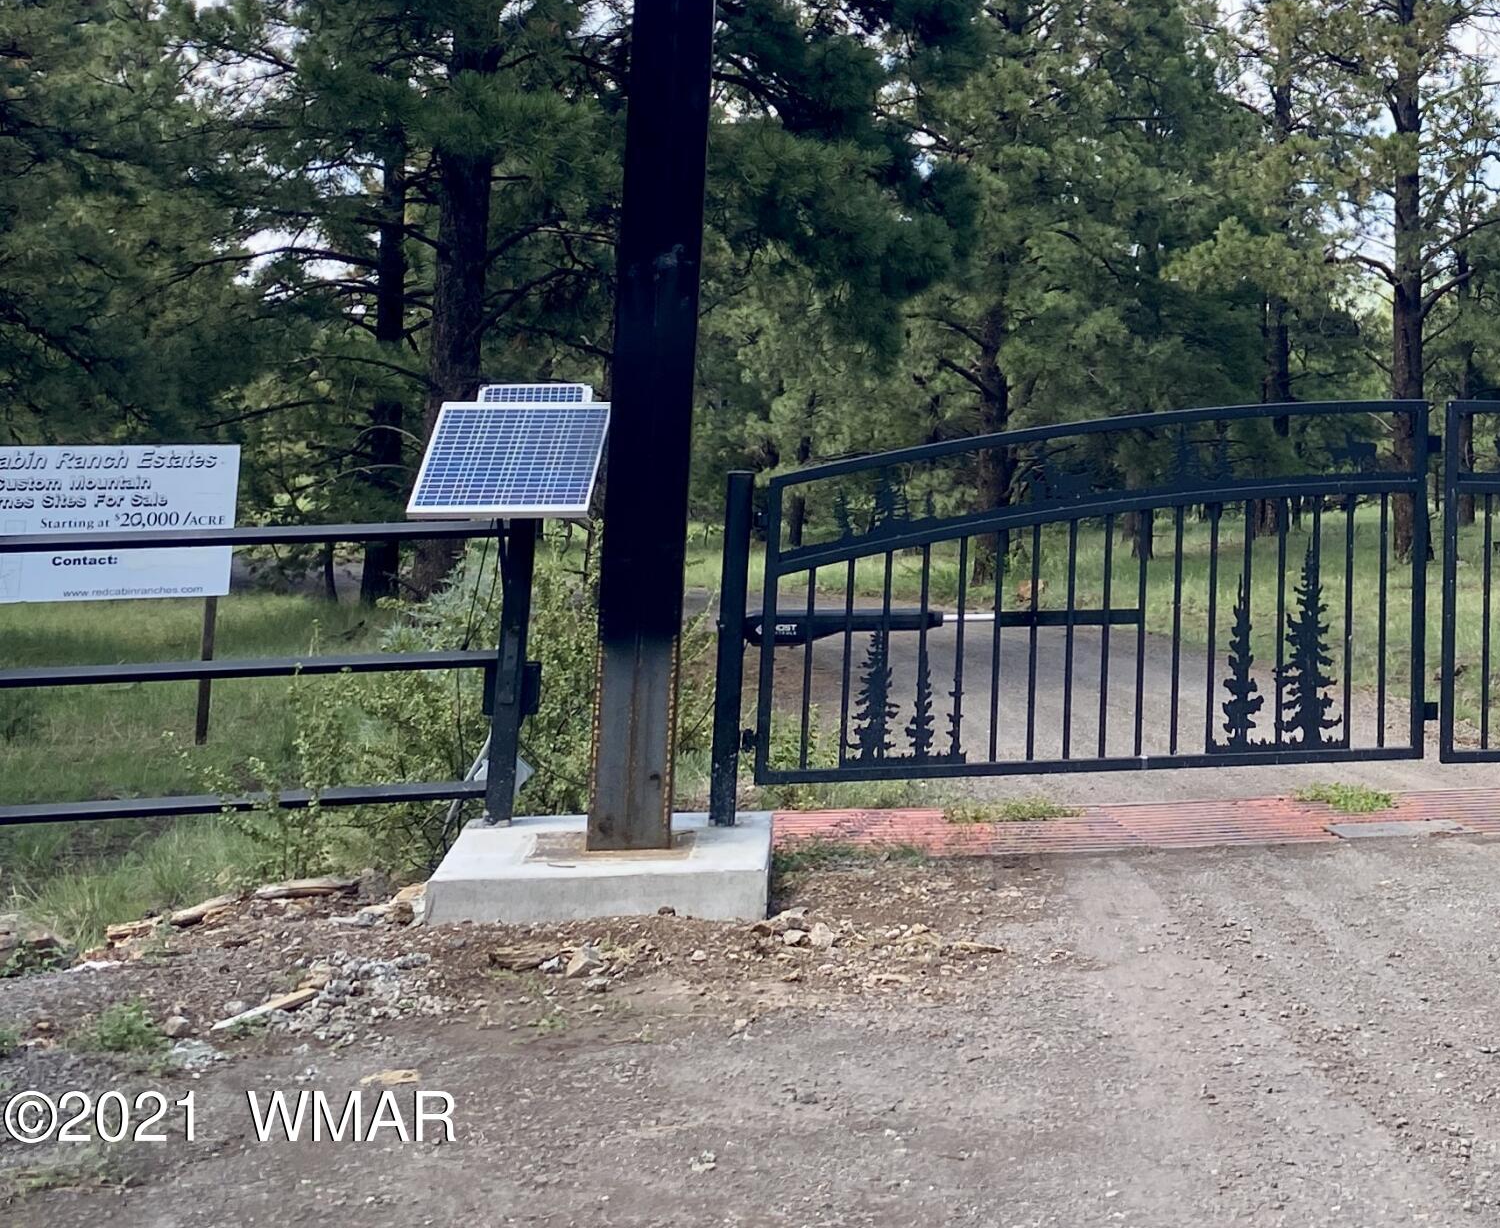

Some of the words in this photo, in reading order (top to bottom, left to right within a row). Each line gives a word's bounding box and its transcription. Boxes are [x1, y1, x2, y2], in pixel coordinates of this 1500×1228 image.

[0, 451, 48, 470] abin
[56, 450, 129, 469] Ranch
[137, 449, 218, 469] Estates
[69, 474, 152, 491] Mountain
[0, 497, 34, 510] mes
[42, 494, 87, 509] Sites
[94, 493, 125, 508] For
[131, 492, 168, 508] Sale
[40, 517, 94, 530] Starting
[97, 518, 109, 528] at
[115, 511, 180, 529] $20,000
[52, 555, 118, 567] Contact:
[63, 585, 204, 598] www.redcabinranches.com
